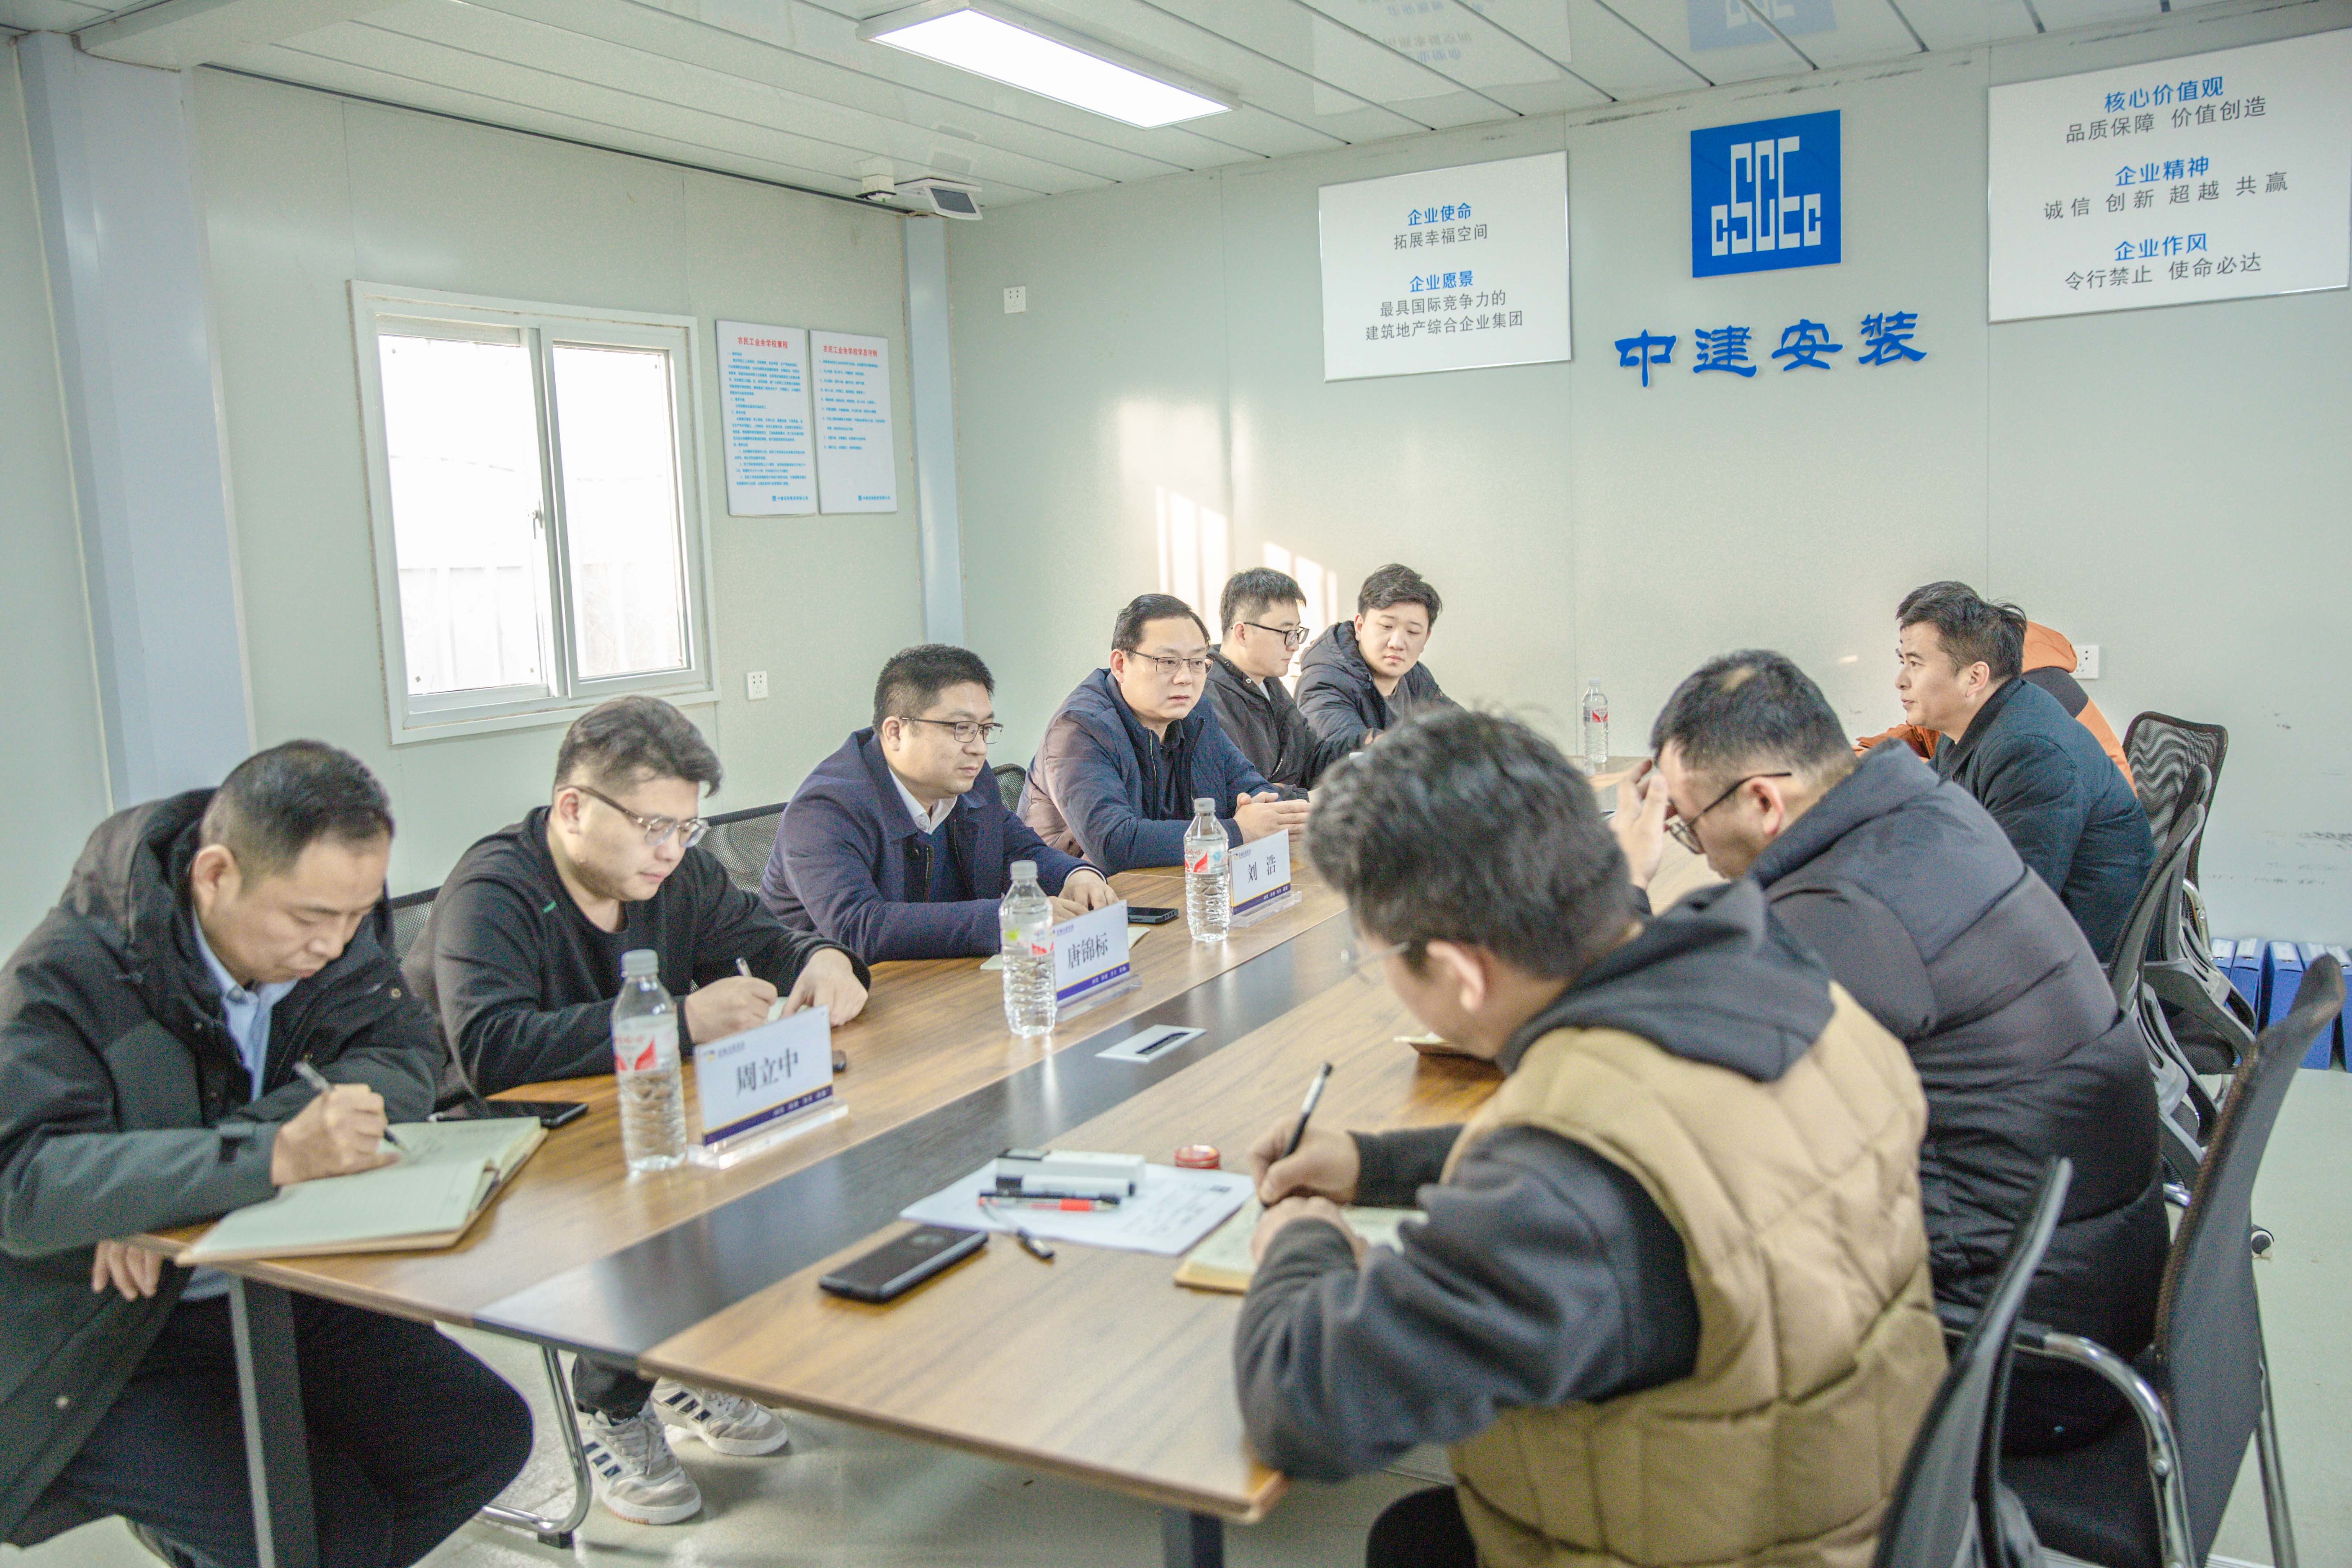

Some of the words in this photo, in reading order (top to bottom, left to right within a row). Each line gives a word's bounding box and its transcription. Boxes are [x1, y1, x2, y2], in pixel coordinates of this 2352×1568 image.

[2105, 76, 2224, 113] 核心价值观
[2066, 113, 2154, 143] 品质保障
[2171, 95, 2266, 128] 价值创造
[2115, 156, 2209, 186] 企业精神
[1408, 202, 1471, 226] 企业使命
[1711, 136, 1821, 256] CSCEC
[2044, 197, 2090, 220] 诚信
[2105, 189, 2154, 213] 创新
[2169, 180, 2219, 205] 超越
[1394, 223, 1487, 250] 拓展幸福空间
[2114, 232, 2207, 261] 企业作风
[1410, 270, 1473, 293] 企业愿景
[2065, 265, 2152, 291] 令行禁止
[2169, 252, 2261, 280] 使命必达
[1380, 289, 1506, 317] 最具国际竞争力的
[1366, 310, 1523, 341] 建筑地产综合企业集团
[1614, 310, 1928, 388] 中建安装
[1068, 932, 1108, 969] 唐锦标
[736, 1048, 798, 1094] 周立中
